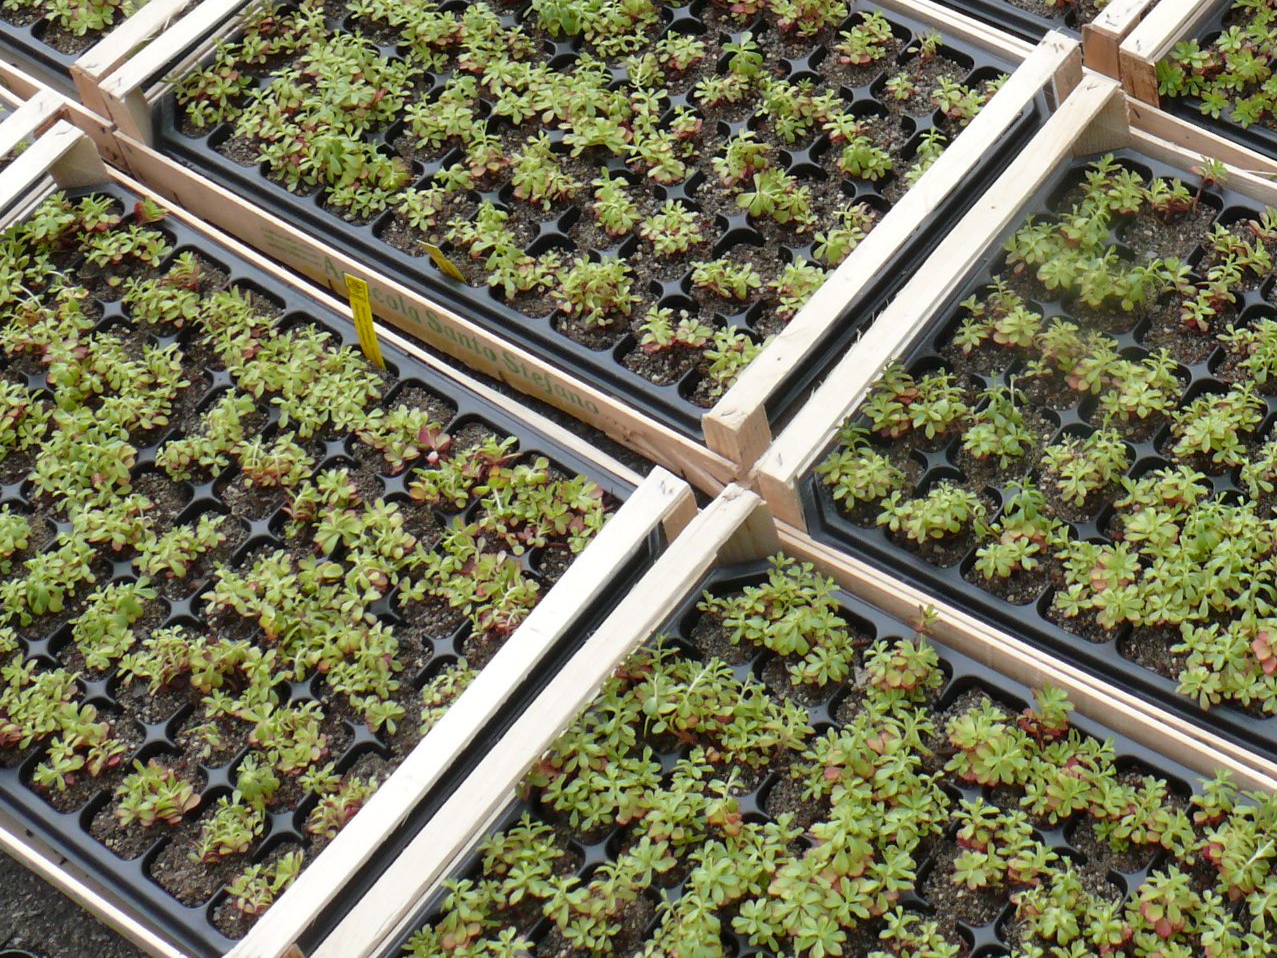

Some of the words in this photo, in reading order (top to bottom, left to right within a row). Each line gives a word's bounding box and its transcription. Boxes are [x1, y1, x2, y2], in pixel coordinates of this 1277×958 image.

[324, 255, 421, 323] Acola
[425, 311, 497, 363] Santo
[501, 351, 600, 415] Stefano
